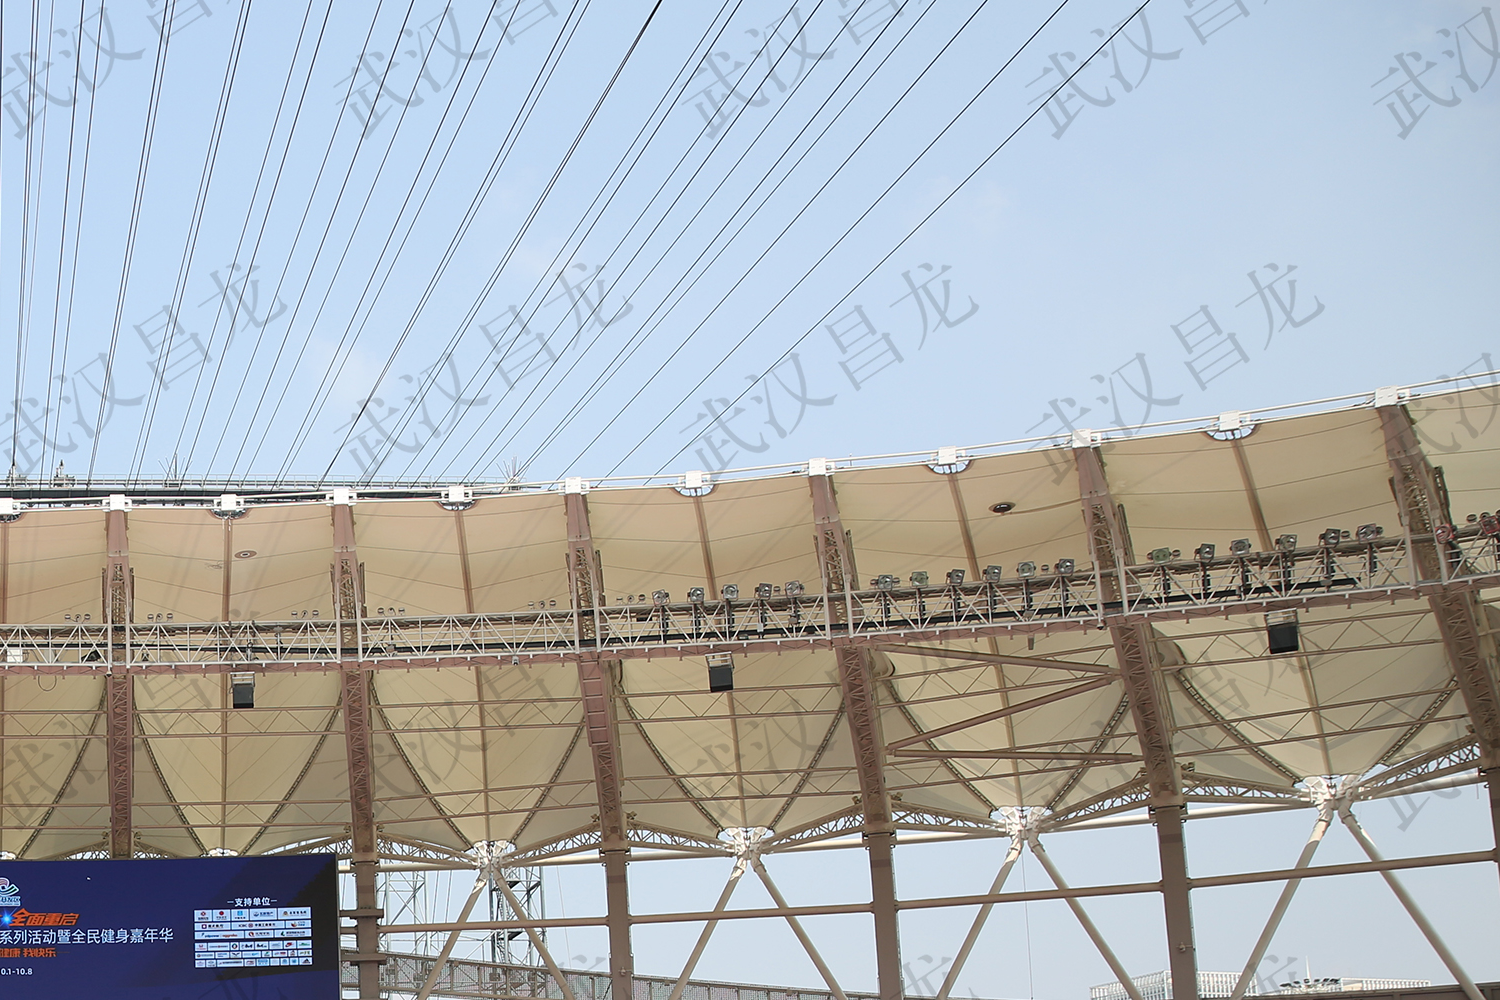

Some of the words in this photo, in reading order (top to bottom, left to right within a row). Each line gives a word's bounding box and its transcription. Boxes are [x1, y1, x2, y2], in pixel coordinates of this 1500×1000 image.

[235, 897, 270, 907] 支持单位
[9, 908, 80, 927] 全面重启
[22, 947, 57, 958] 我快乐
